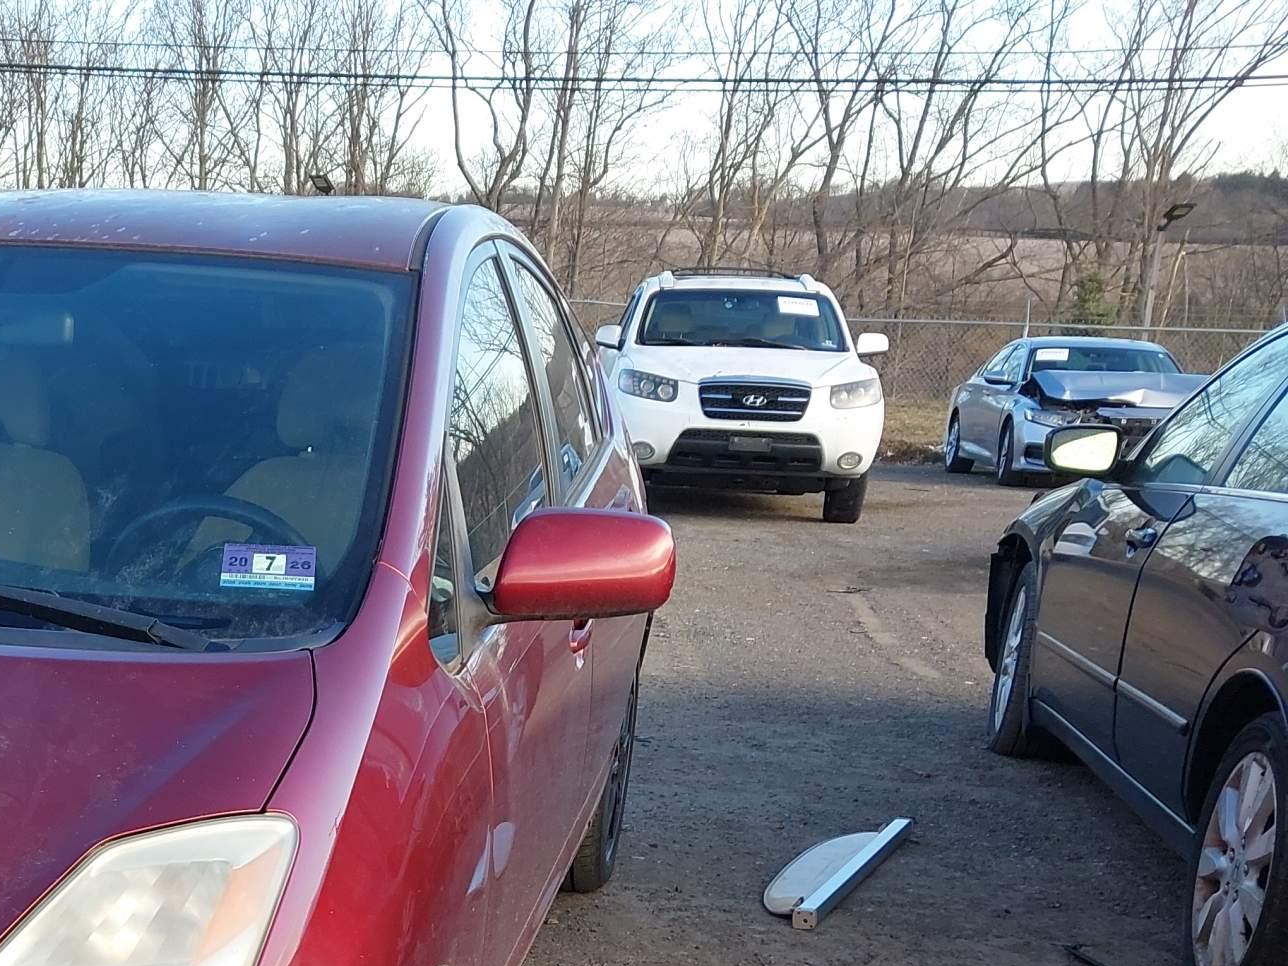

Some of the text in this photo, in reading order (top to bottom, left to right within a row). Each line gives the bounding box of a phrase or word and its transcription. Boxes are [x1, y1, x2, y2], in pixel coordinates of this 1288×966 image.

[228, 555, 312, 571] 20 7 26
